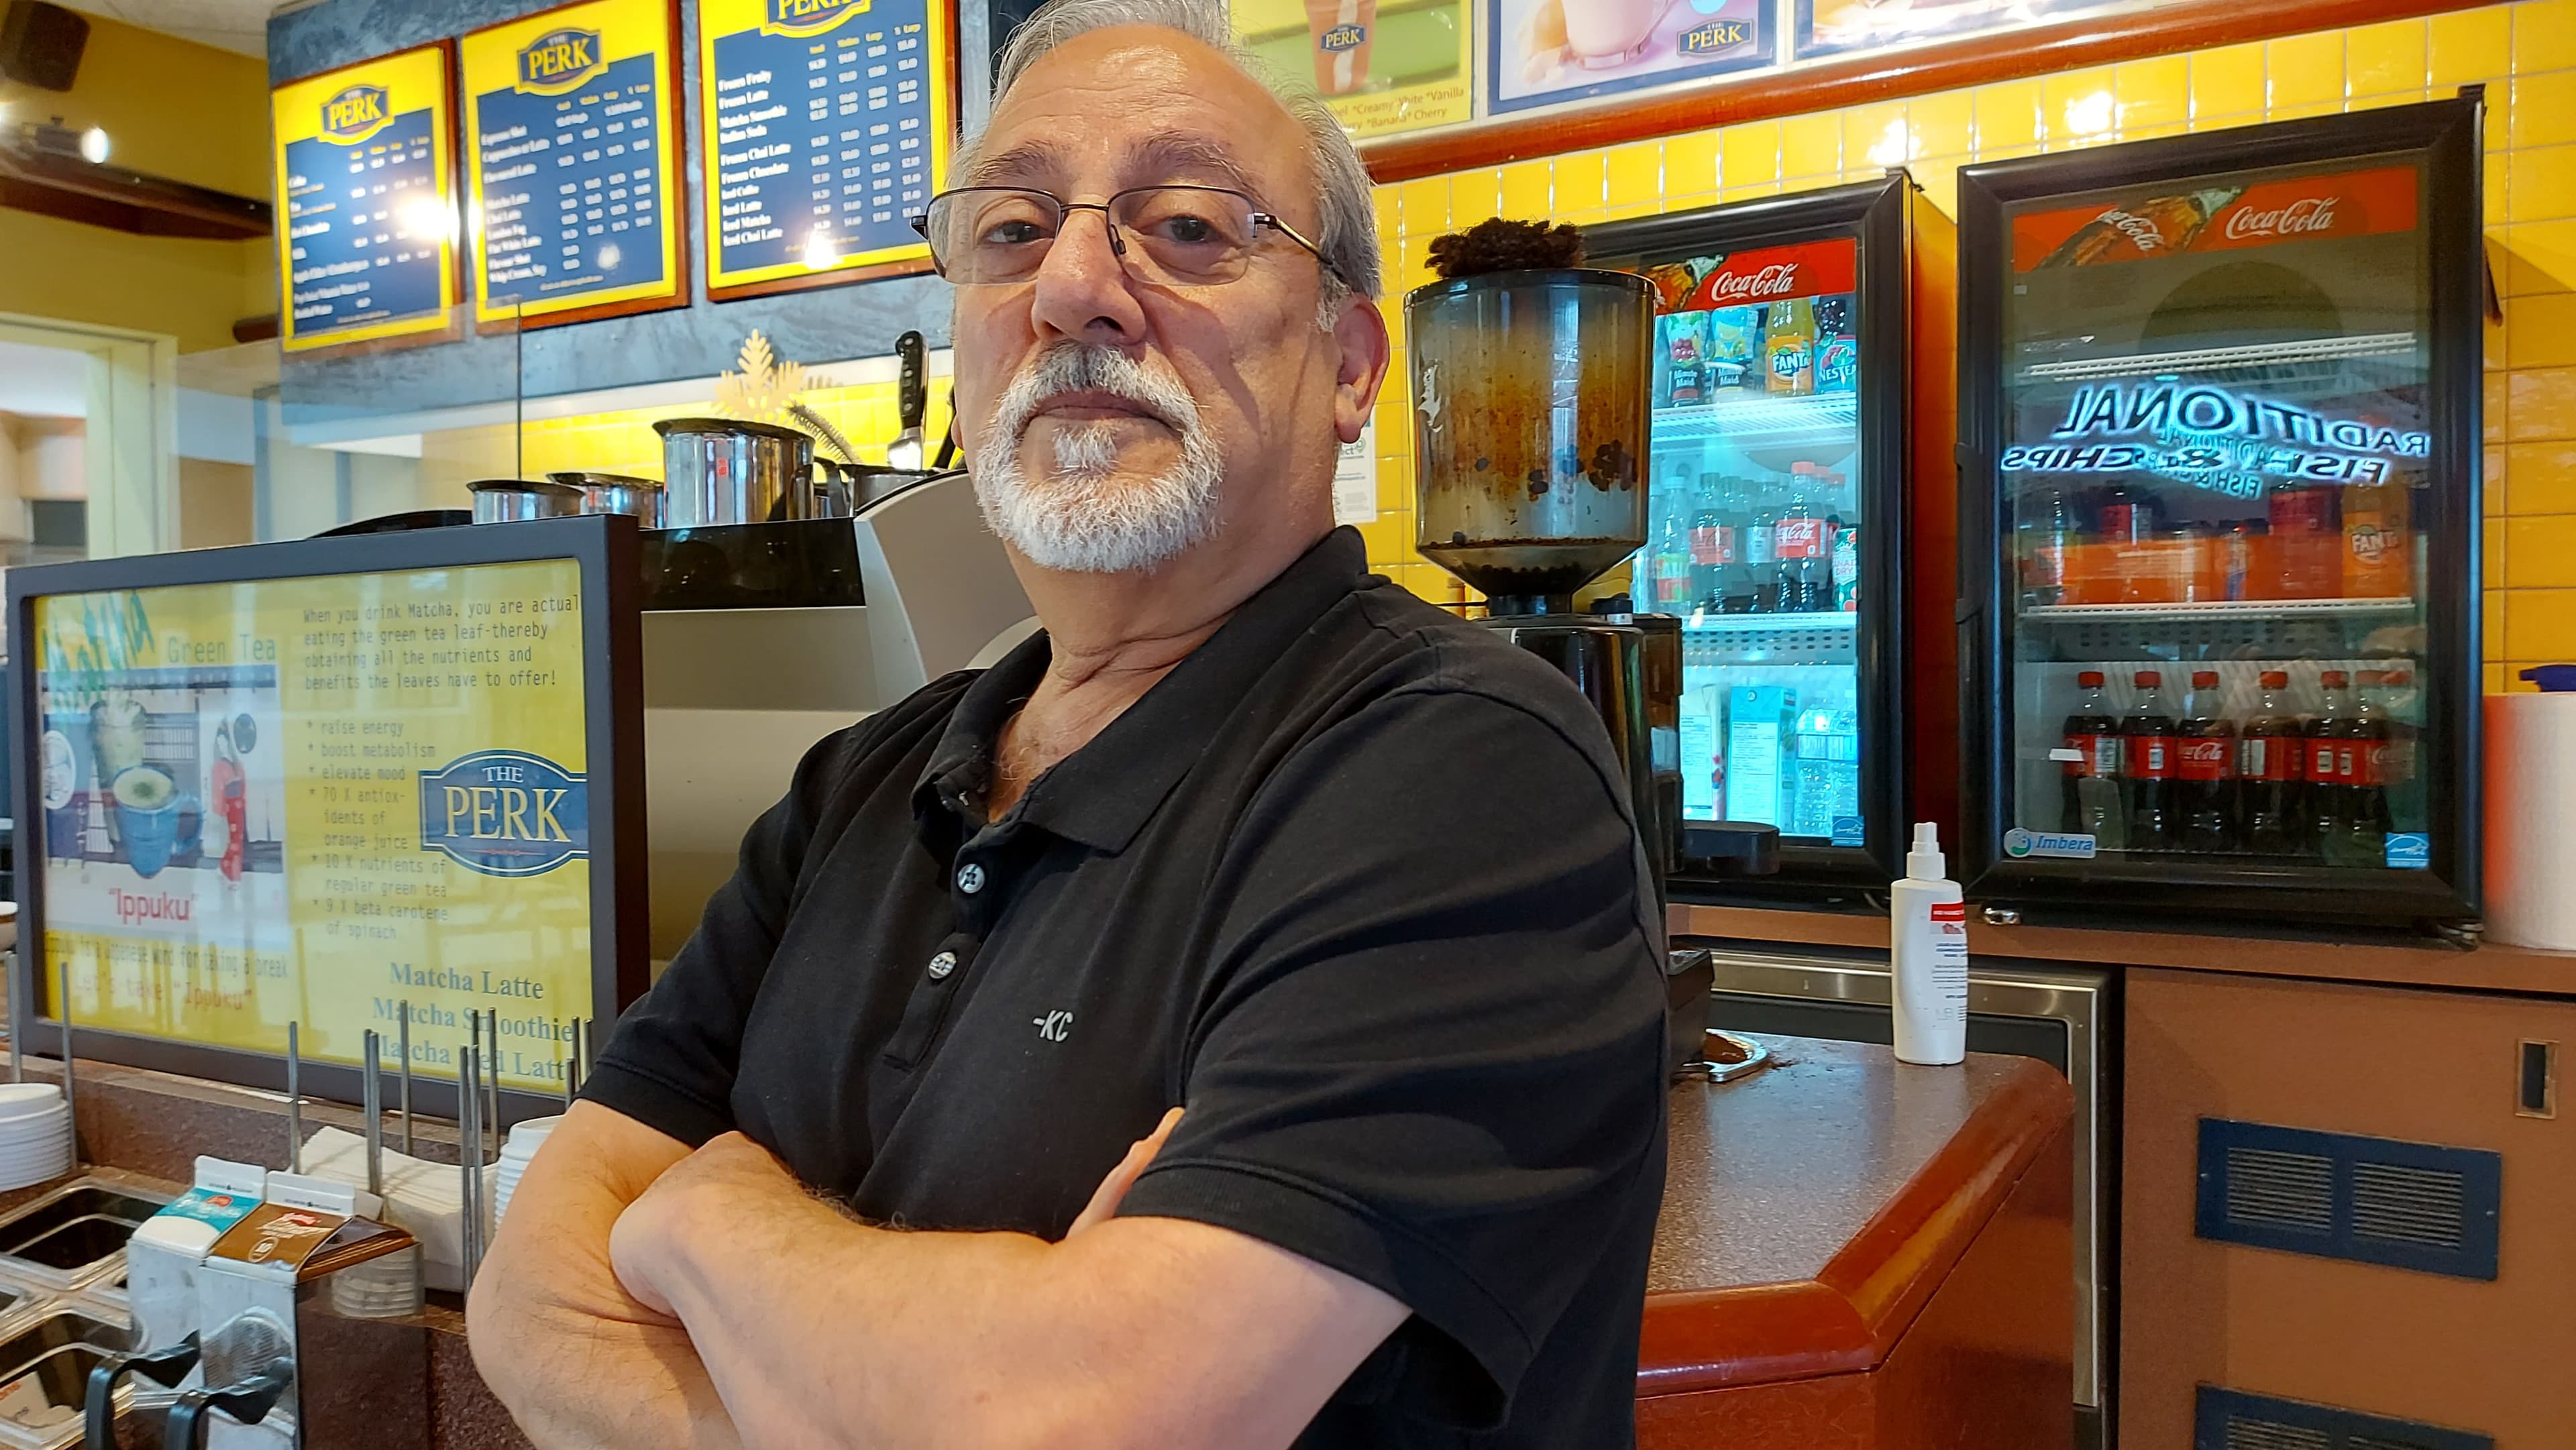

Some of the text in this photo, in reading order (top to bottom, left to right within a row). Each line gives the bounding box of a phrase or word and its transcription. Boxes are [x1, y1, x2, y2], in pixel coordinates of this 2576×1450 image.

[1326, 29, 1360, 48] PERK
[1688, 24, 1743, 51] PERK
[527, 38, 593, 79] PERK
[328, 93, 382, 131] PERK
[1413, 107, 1448, 121] Cherry
[2226, 196, 2341, 240] Coca-Cola
[1711, 263, 1799, 302] Coca-Cola
[304, 594, 578, 624] When you drink Matcha, you are actual
[305, 620, 548, 647] eating the green tea leaf-thereby
[168, 633, 276, 664] Green Tea
[305, 645, 532, 669] obtaining all the nutrients and
[305, 669, 556, 691] benefits the leaves have to offer!
[321, 720, 405, 737] raise energy
[321, 741, 436, 758] boost metabolism
[322, 765, 406, 781] elevate mood
[482, 766, 524, 783] THE
[357, 789, 406, 803] antiox-
[323, 808, 386, 825] idents of
[442, 786, 572, 843] PERK
[324, 833, 409, 851] orange juice
[2036, 836, 2094, 850] Imbera
[325, 853, 339, 869] 10
[360, 856, 424, 873] nutrients
[431, 858, 447, 874] of
[326, 877, 447, 898] regular green tea
[354, 899, 382, 916] beta
[388, 903, 449, 921] carotene
[326, 921, 397, 941] of spinach
[388, 962, 545, 999] Matcha Latte
[378, 1035, 451, 1064] acha
[514, 1052, 568, 1081] Latt
